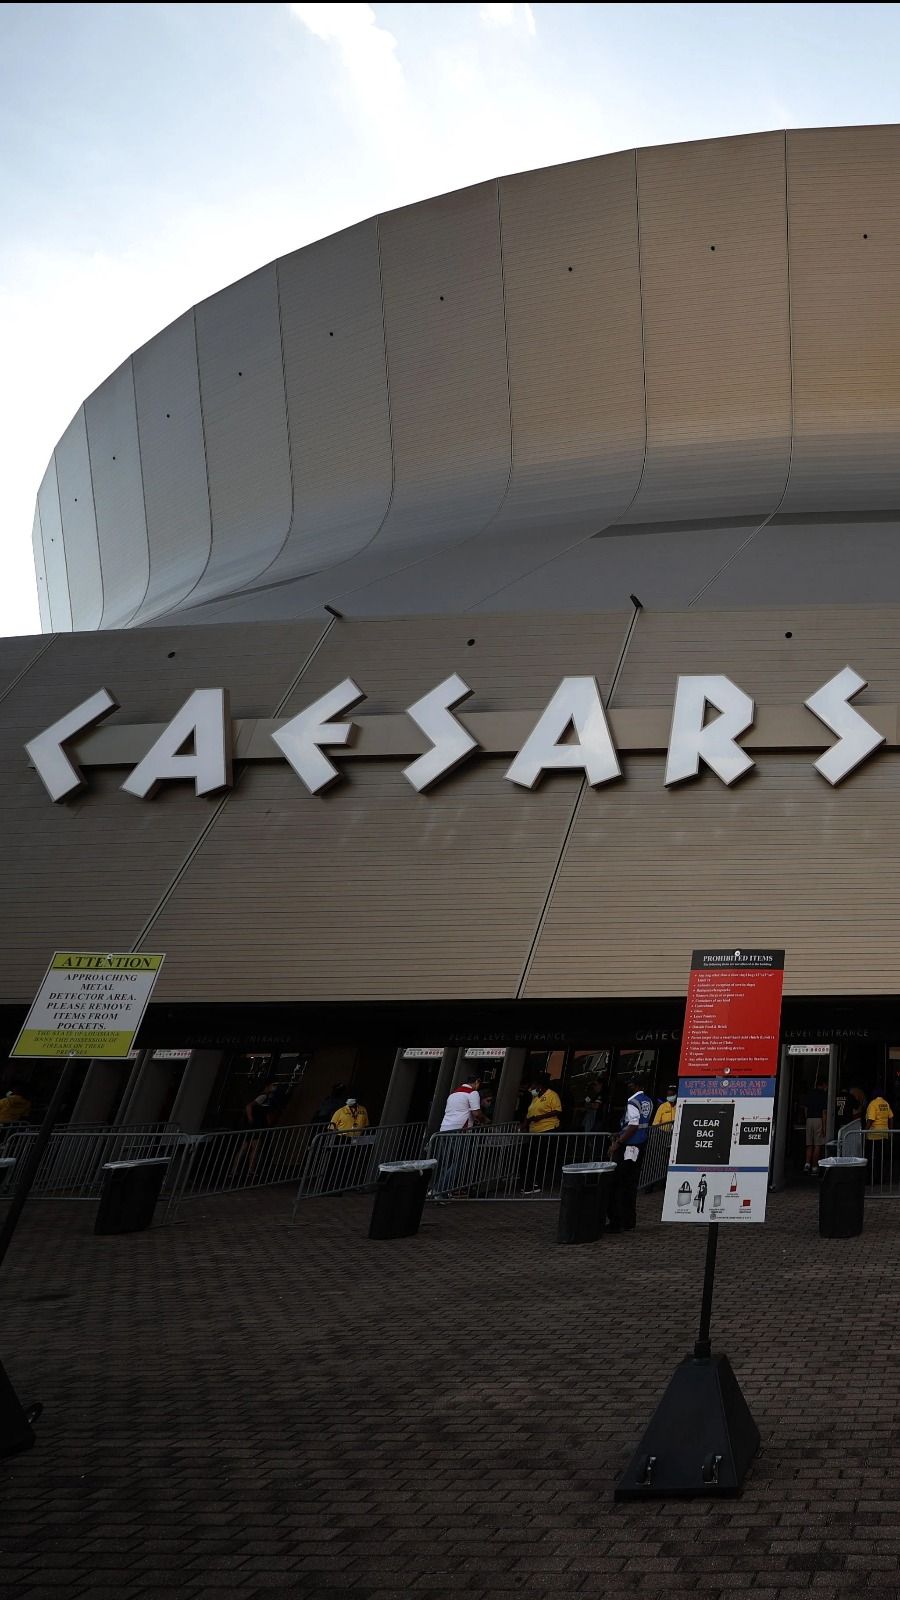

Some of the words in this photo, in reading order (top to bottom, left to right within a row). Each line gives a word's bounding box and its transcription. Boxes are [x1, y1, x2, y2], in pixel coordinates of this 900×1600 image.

[24, 666, 886, 802] CAESARS
[62, 957, 152, 968] ATTENTION
[64, 973, 138, 982] APPROACHING
[81, 983, 114, 991] METAL
[49, 992, 105, 1001] DETECTOR
[105, 993, 137, 1001] AREA.
[46, 1002, 86, 1010] PLEASE
[88, 1003, 132, 1011] REMOVE
[53, 1012, 86, 1020] ITEMS
[87, 1012, 118, 1021] FROM
[57, 1022, 107, 1030] POCKETS.
[816, 1029, 871, 1039] ENTRANCE
[836, 1101, 846, 1116] 7
[693, 1119, 720, 1127] CLEAR
[696, 1130, 714, 1138] BAG
